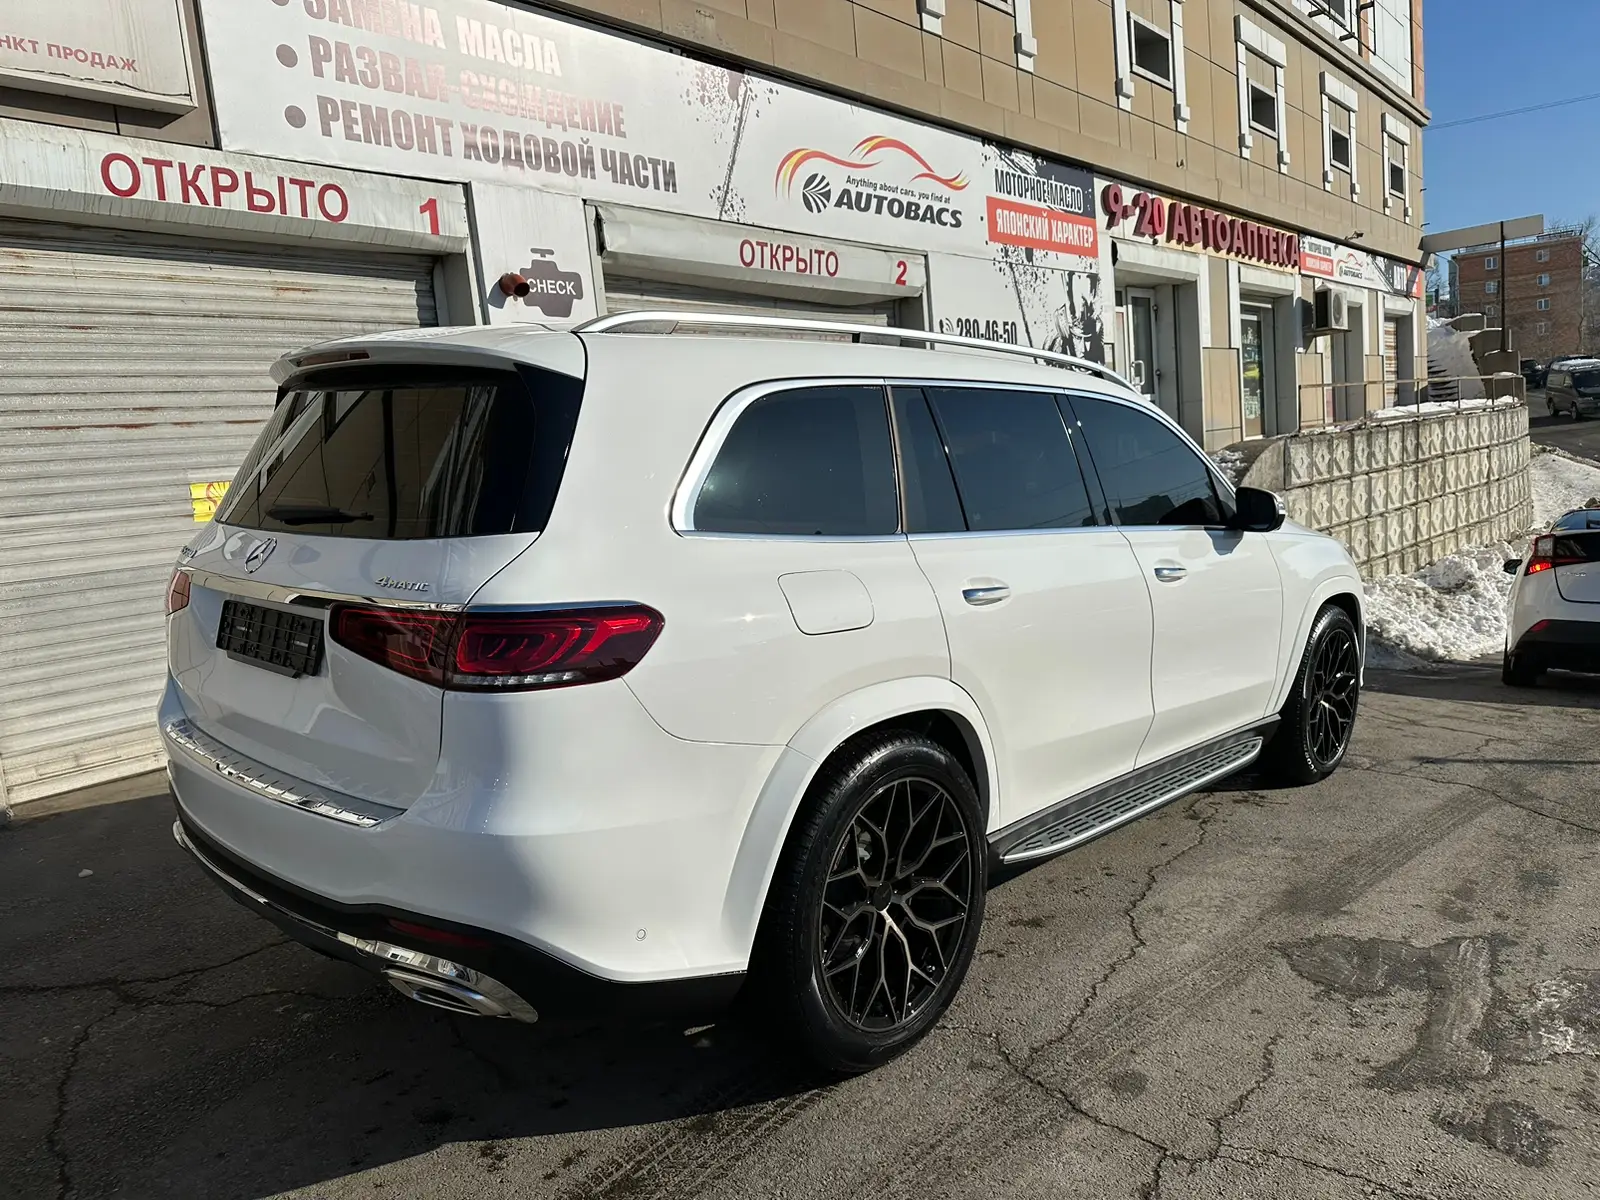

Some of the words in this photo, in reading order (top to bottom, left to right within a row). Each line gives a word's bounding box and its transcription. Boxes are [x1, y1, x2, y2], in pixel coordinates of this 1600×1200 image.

[47, 43, 138, 72] ПРОДАЖ
[456, 16, 562, 77] МАСЛА
[316, 95, 454, 157] РЕМОНТ
[460, 121, 597, 180] ХОДОВОЙ
[600, 148, 678, 193] ЧАСТИ
[100, 152, 349, 223] ОТКРЫТО
[846, 175, 877, 191] Anything
[880, 182, 898, 194] about
[918, 191, 929, 200] you
[931, 192, 943, 203] find
[944, 196, 951, 204] at
[995, 168, 1047, 204] МОТОРНОЕ
[1049, 182, 1082, 212] МАСЛО
[419, 198, 440, 235] 1
[834, 188, 962, 228] AUTOBACS
[1101, 184, 1165, 239] 9-20
[1166, 202, 1300, 269] АВТОАПТЕКА
[996, 209, 1049, 241] ЯПОНСКИЙ
[1051, 219, 1094, 248] ХАРАКТЕР
[739, 239, 839, 277] ОТКРЫТО
[896, 260, 908, 286] 2
[527, 278, 577, 295] CHECK
[956, 317, 1018, 345] 280-46-50
[375, 576, 430, 592] 4MATIC
